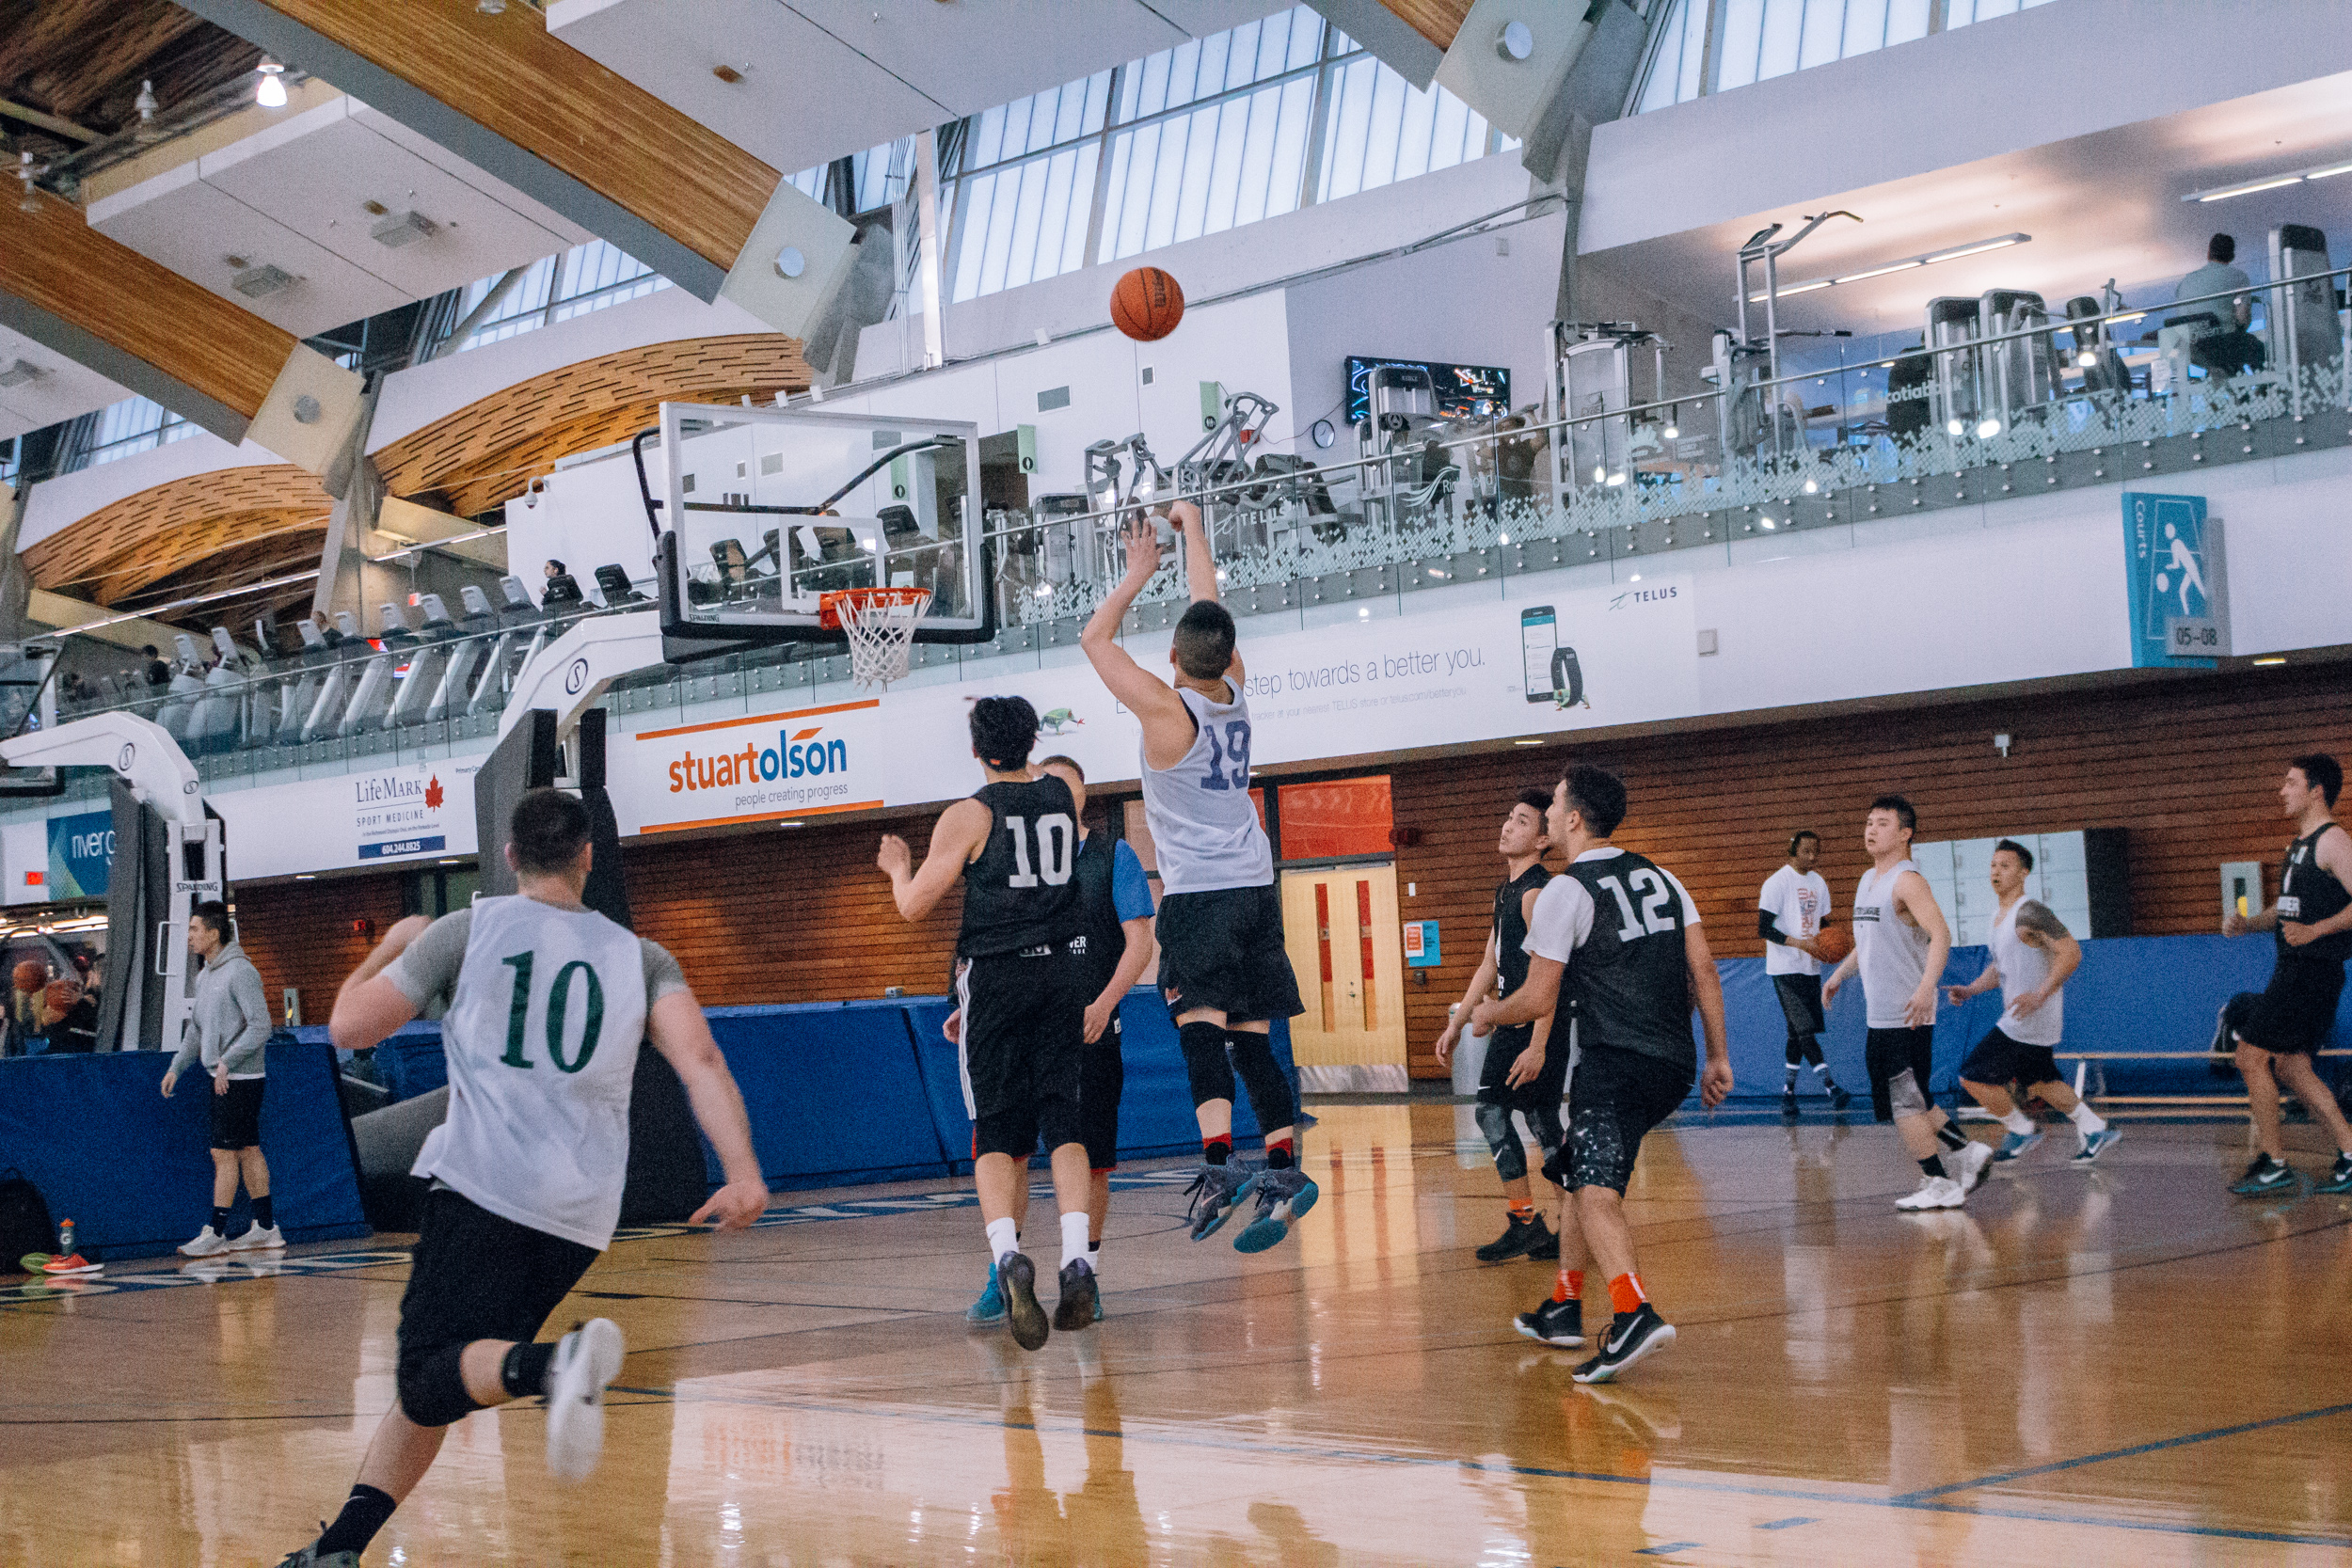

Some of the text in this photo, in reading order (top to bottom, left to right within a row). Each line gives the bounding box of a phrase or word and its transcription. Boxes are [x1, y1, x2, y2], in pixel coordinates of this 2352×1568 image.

[2135, 499, 2148, 559] Courts
[1634, 587, 1677, 603] TELUS
[2175, 626, 2218, 646] 05-08
[1244, 647, 1486, 699] step towards a better you.
[1332, 700, 1359, 710] TELUS
[1200, 720, 1251, 790] 19
[735, 783, 849, 811] people creating progress
[357, 809, 424, 828] SPORT MEDICINE
[72, 831, 105, 859] river
[1006, 813, 1073, 888] 10
[1597, 868, 1676, 942] 12
[499, 950, 605, 1074] 10
